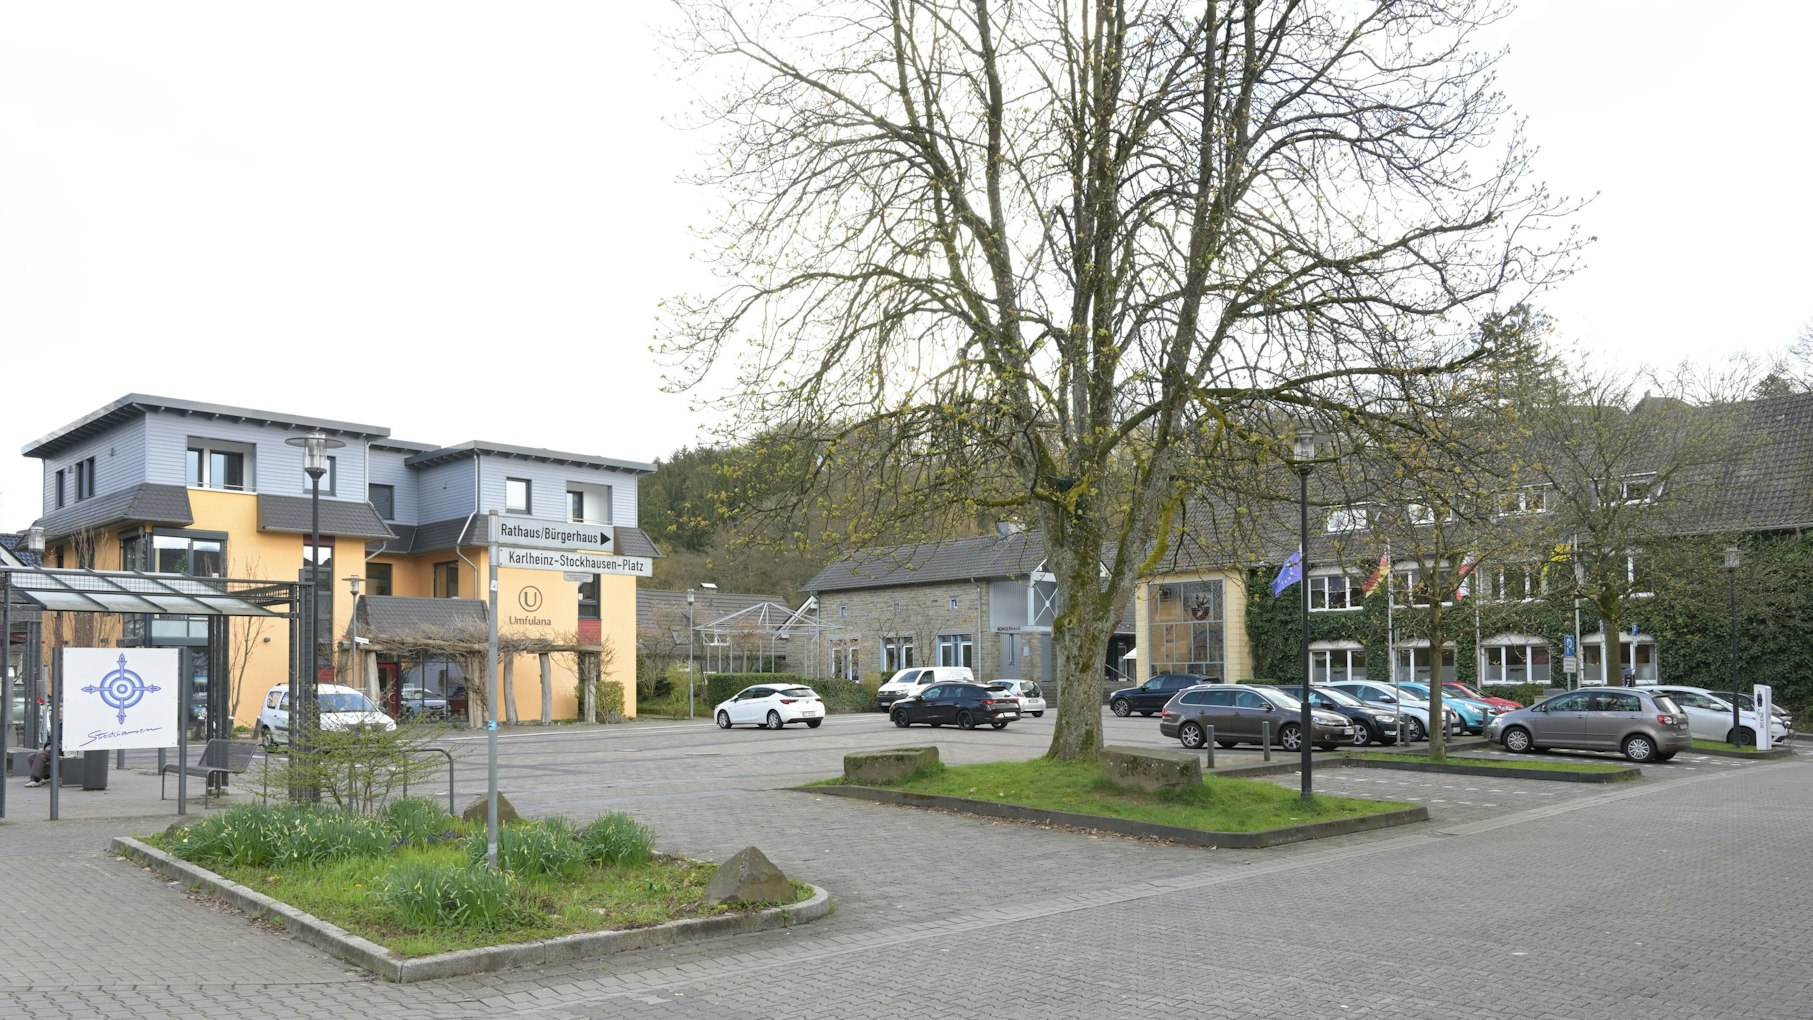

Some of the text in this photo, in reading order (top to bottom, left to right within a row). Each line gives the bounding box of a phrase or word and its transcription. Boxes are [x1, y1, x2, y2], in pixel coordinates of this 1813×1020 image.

[501, 523, 598, 544] Rathaus/Bürgerhaus
[509, 551, 644, 571] Karlheinz-Stockhausen-Platz
[524, 591, 537, 607] U
[509, 615, 552, 626] Umfulana
